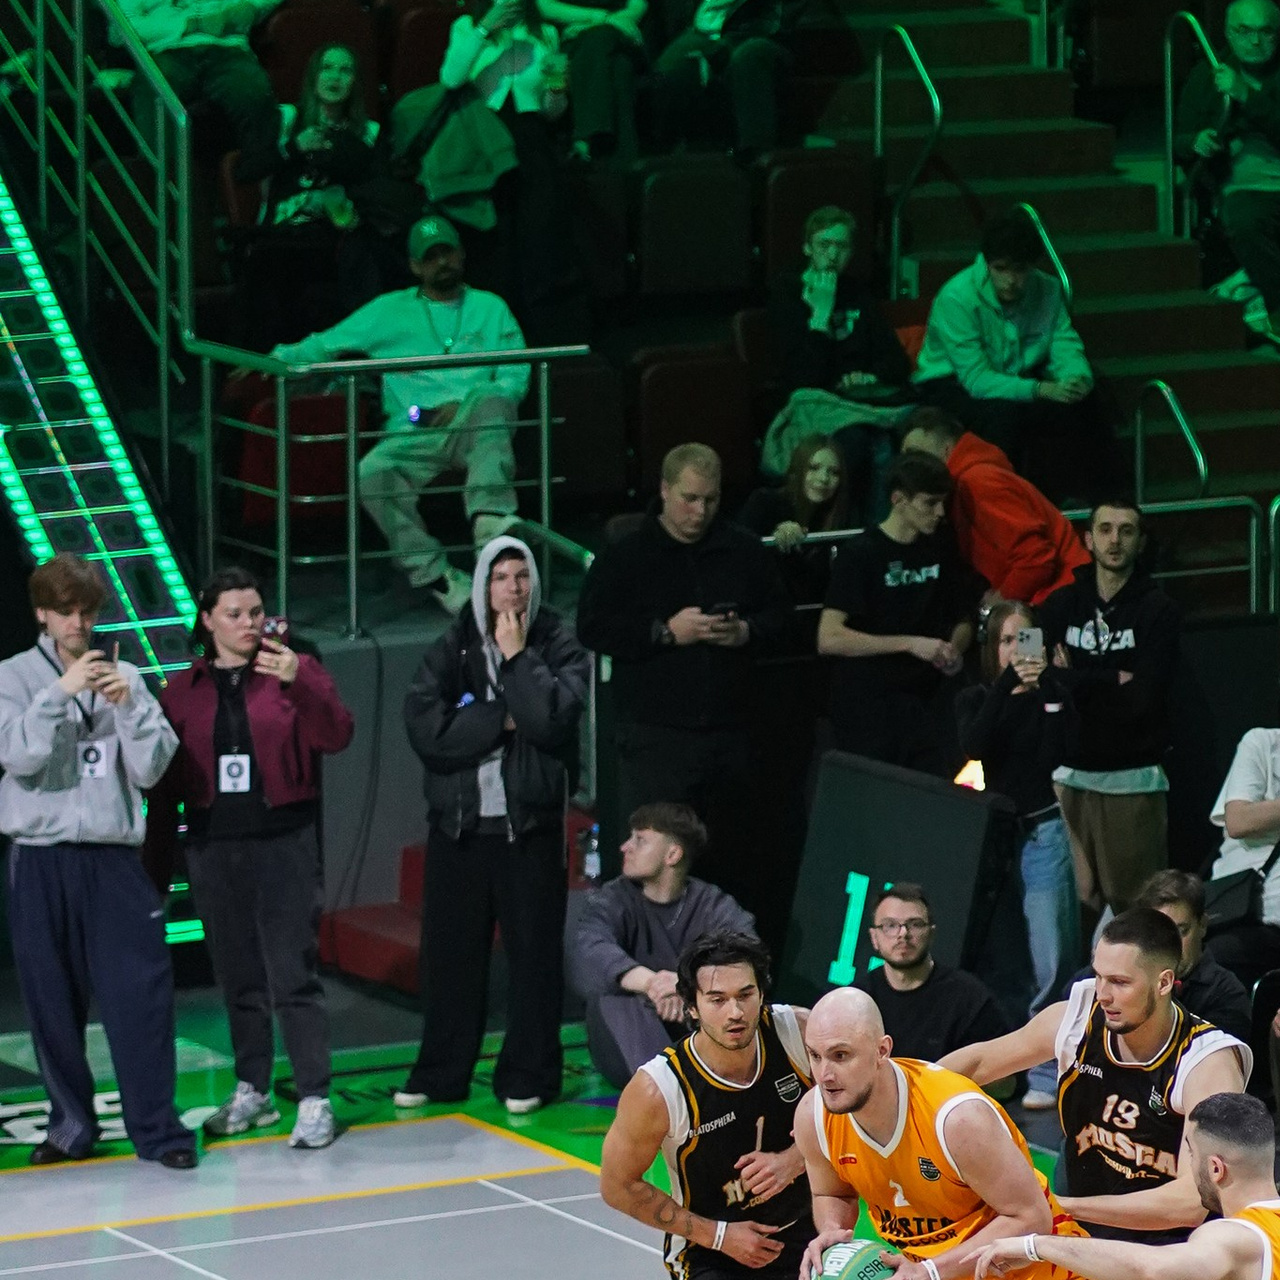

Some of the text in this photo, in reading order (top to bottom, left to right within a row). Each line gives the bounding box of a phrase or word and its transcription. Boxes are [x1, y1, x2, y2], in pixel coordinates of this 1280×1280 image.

[688, 1111, 736, 1139] BLATOSPHERA
[1102, 1094, 1140, 1129] 13
[889, 1179, 911, 1207] 2
